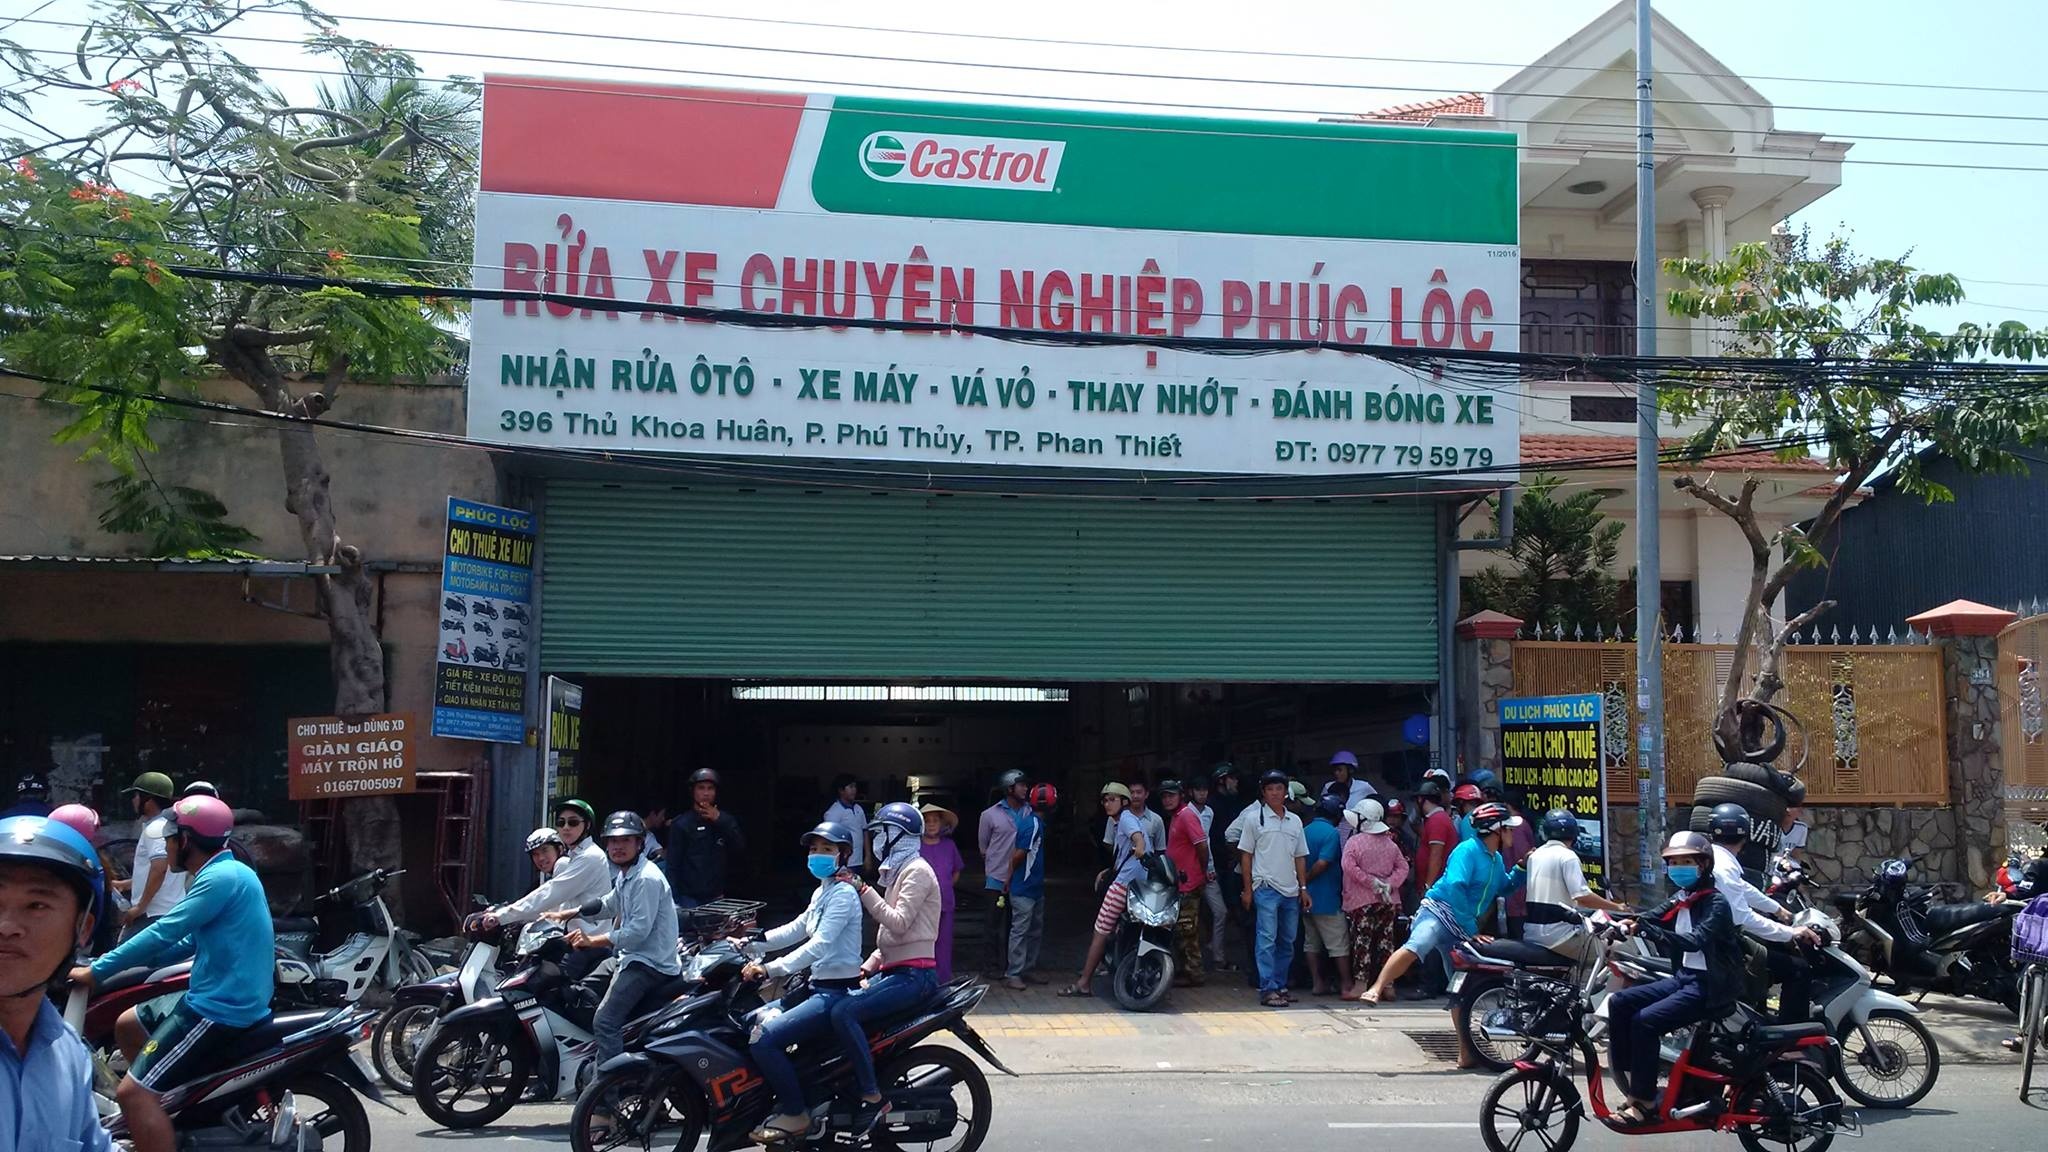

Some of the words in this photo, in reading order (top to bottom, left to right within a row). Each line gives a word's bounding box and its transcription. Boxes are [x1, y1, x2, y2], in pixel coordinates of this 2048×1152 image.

[909, 139, 1050, 184] Castrol
[502, 213, 620, 321] RỬA
[639, 249, 719, 325] XE
[740, 245, 976, 337] CHUYÊN
[1000, 258, 1204, 368] NGHIỆP
[1221, 261, 1368, 357] PHÚC
[1390, 268, 1494, 380] LỘC
[500, 348, 596, 399] NHẬN
[611, 347, 678, 394] RỬA
[690, 353, 755, 397] ÔTÔ
[797, 367, 842, 401] XE
[853, 363, 919, 404] MÁY
[951, 367, 989, 408] VÁ
[996, 365, 1036, 409] VỎ
[1068, 380, 1145, 414] THAY
[1156, 376, 1239, 417] NHỚT
[1272, 381, 1353, 420] ĐÁNH
[1364, 384, 1446, 424] BÓNG
[1455, 394, 1495, 424] XE
[500, 410, 553, 433] 396
[563, 411, 618, 436] Thủ
[631, 415, 705, 440] Khoa
[716, 418, 793, 447] Huân,
[805, 422, 826, 444] P.
[837, 424, 889, 447] Phú
[898, 424, 972, 455] Thủy,
[985, 429, 1025, 452] TP.
[1036, 432, 1104, 455] Phan
[1115, 433, 1183, 458] Thiết
[1275, 441, 1318, 462] ĐT:
[1327, 443, 1387, 465] 0977
[1393, 445, 1424, 466] 79
[1430, 446, 1459, 468] 59
[1464, 447, 1494, 468] 79
[455, 506, 497, 523] PHÚC
[501, 514, 531, 530] LỘC
[450, 528, 470, 555] CHO
[472, 530, 497, 560] THUÊ
[498, 537, 512, 562] XE
[512, 535, 533, 565] MÁY
[450, 561, 493, 578] MOTORBIKE
[494, 567, 509, 579] FOR
[480, 672, 491, 682] XE
[1520, 705, 1541, 723] LỊCH
[1543, 700, 1571, 719] PHÚC
[1573, 699, 1594, 722] LỘC
[297, 724, 317, 737] CHO
[319, 720, 344, 735] THUÊ
[302, 740, 350, 756] GIÀN
[356, 738, 404, 754] GIÁO
[1504, 725, 1542, 759] CHUYÊN
[1544, 730, 1565, 759] CHO
[1567, 723, 1597, 759] THUÊ
[300, 758, 333, 775] MÁY
[337, 756, 378, 774] TRỘN
[1568, 768, 1582, 788] CAO
[1548, 794, 1568, 811] 16C
[1576, 795, 1598, 815] 30C
[513, 997, 538, 1011] YAMAHA
